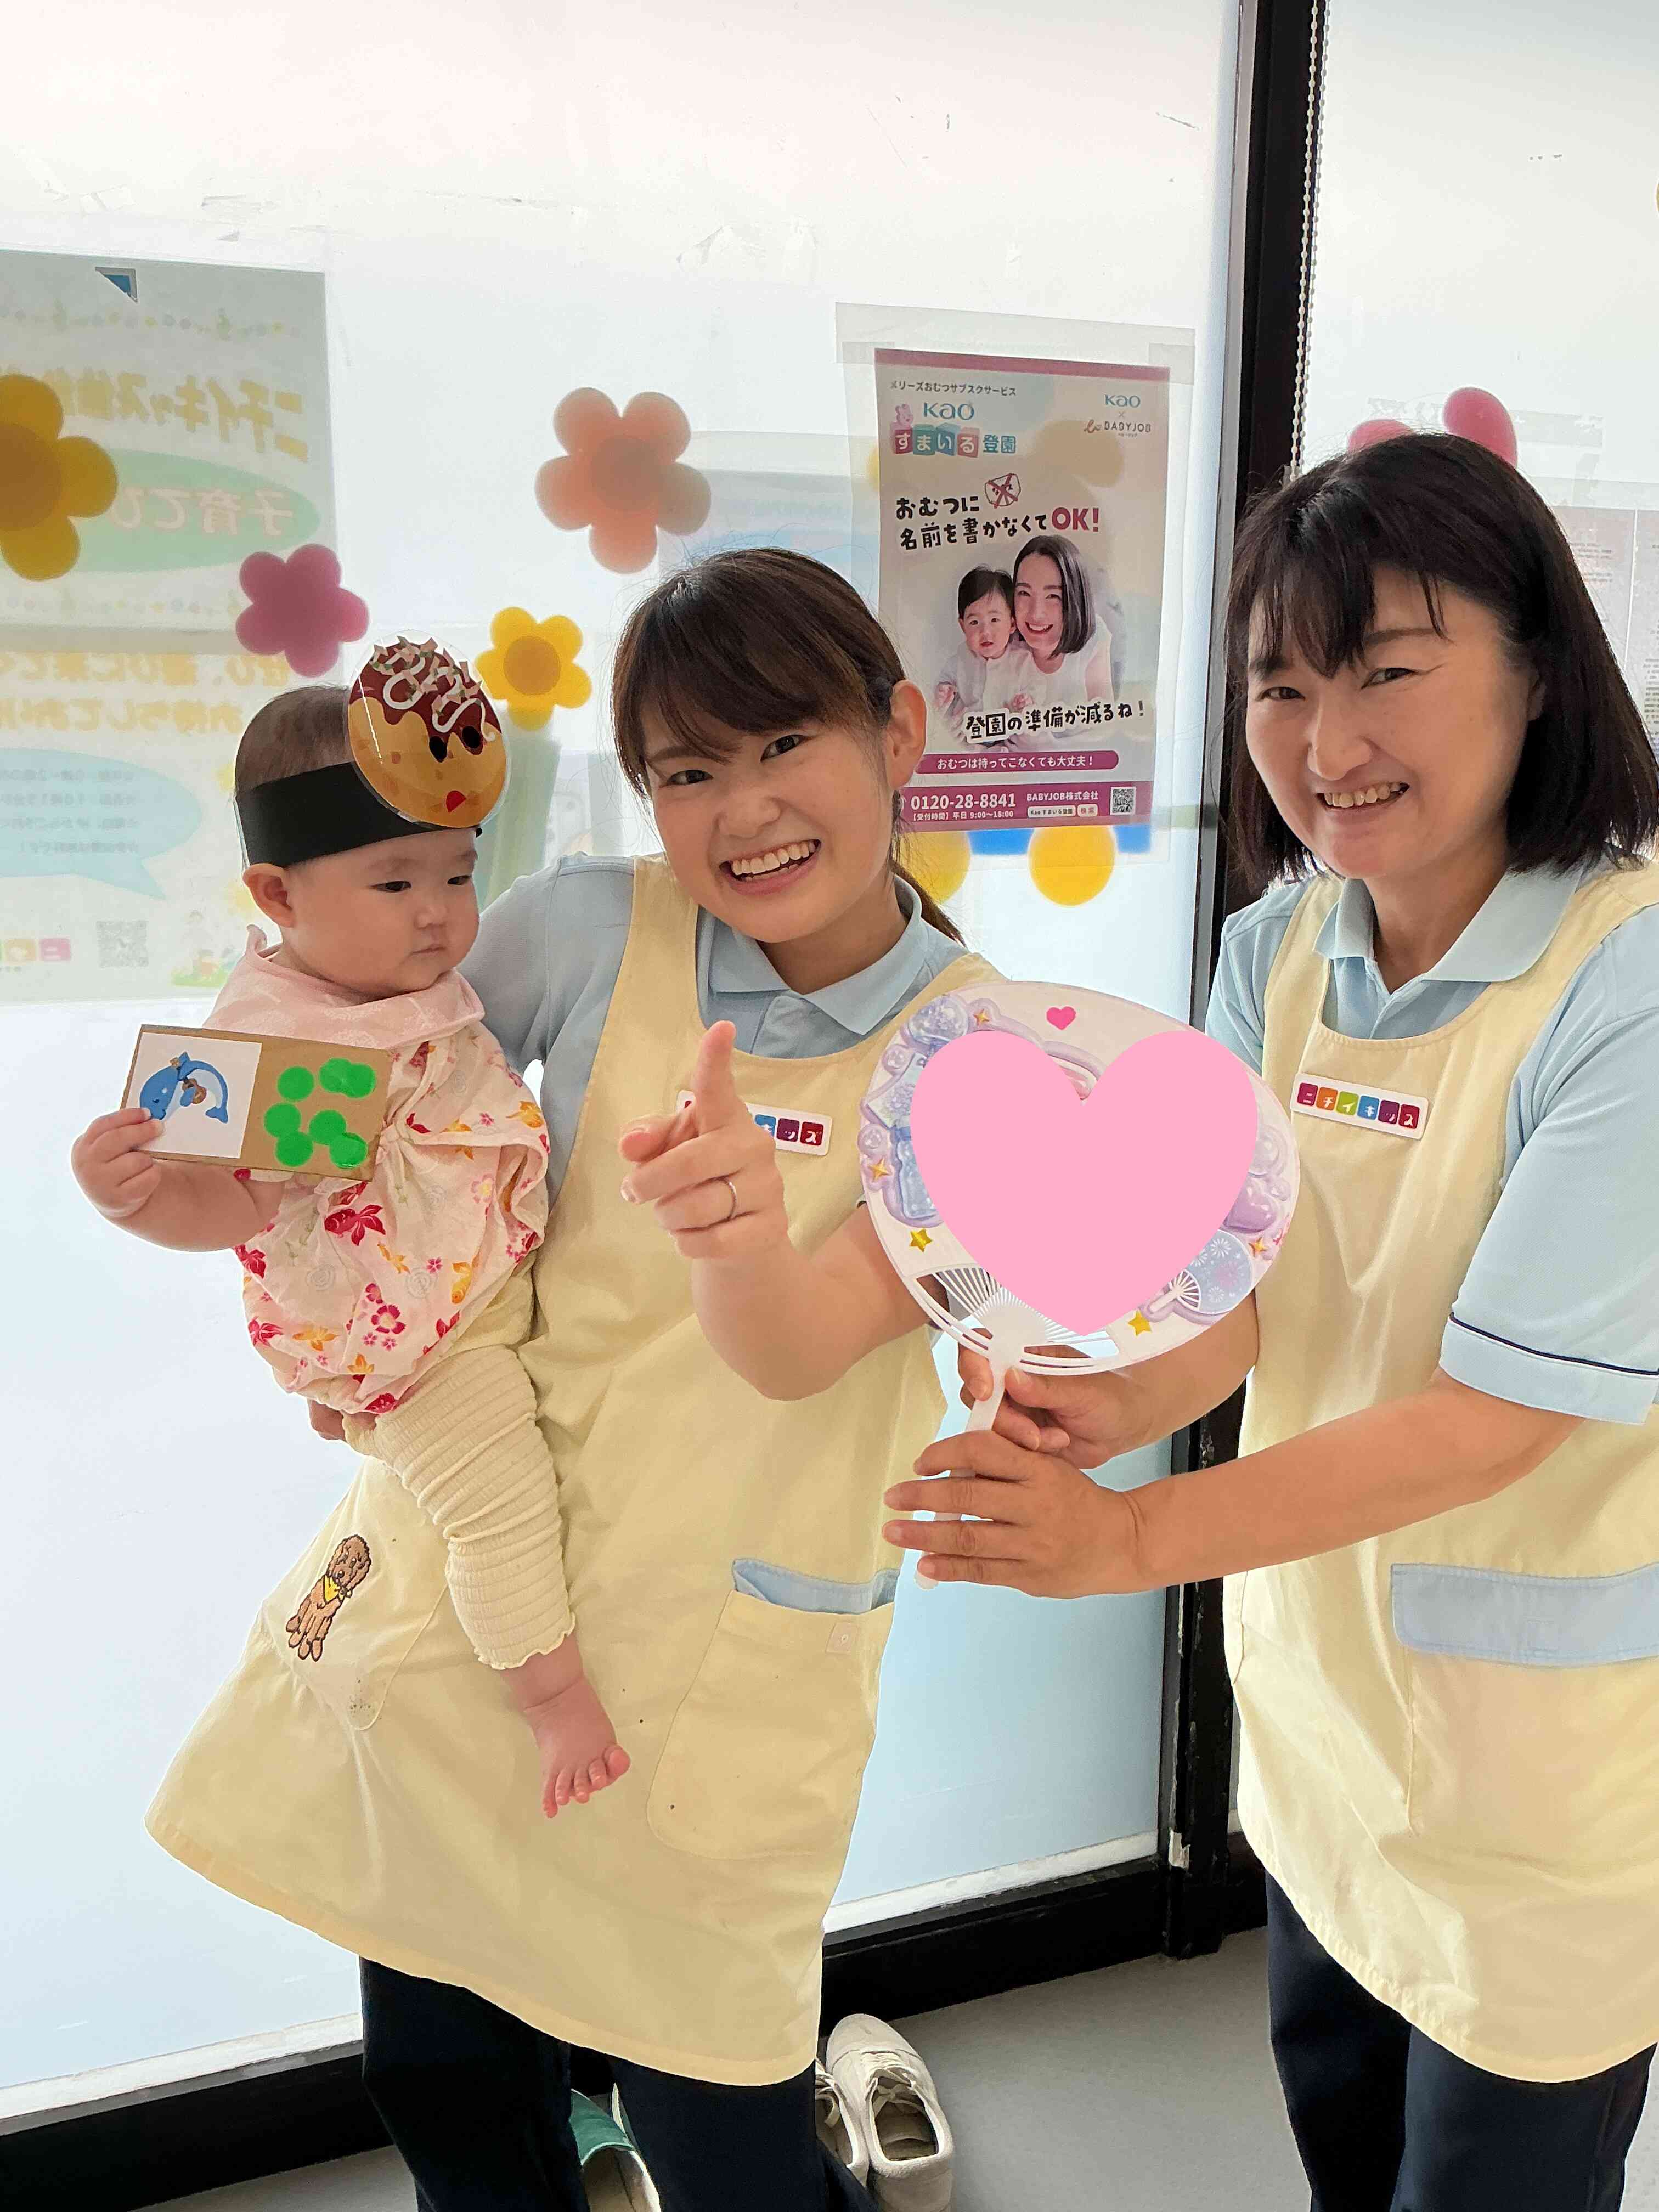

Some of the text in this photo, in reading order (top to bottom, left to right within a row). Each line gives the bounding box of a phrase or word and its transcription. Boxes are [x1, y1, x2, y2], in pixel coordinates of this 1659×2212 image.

[896, 496, 979, 520] おむつに
[911, 793, 1016, 810] 0120-28-8841
